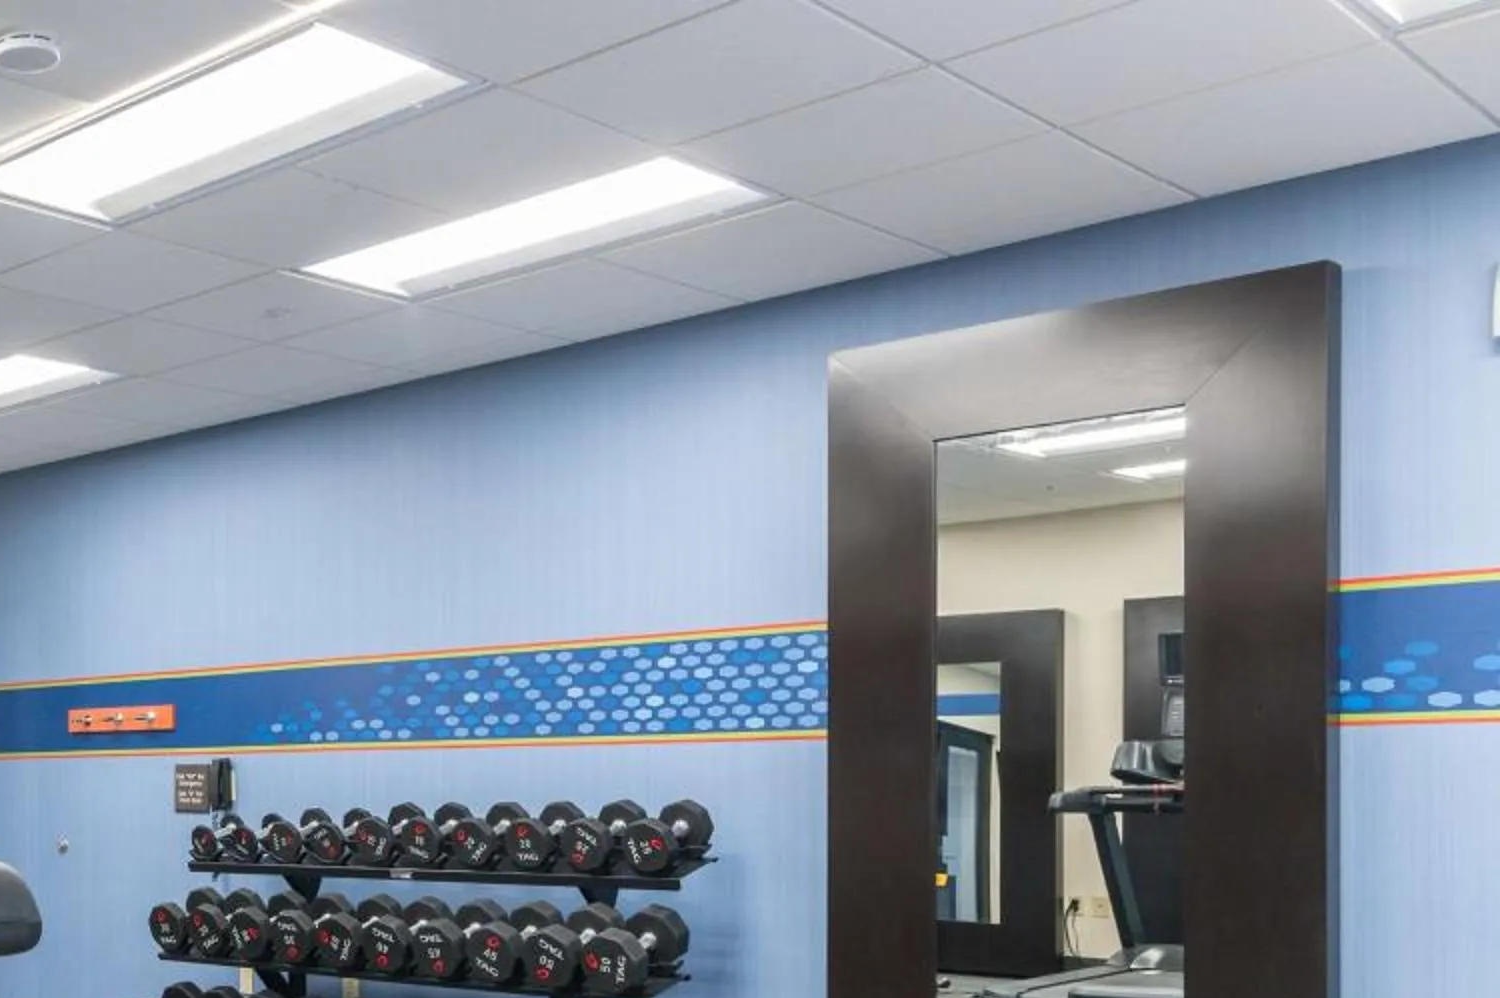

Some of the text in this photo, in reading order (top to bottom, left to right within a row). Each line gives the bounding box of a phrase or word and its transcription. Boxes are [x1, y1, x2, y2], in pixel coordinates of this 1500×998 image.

[627, 837, 642, 864] TAG
[372, 927, 395, 943] TAG
[419, 933, 444, 944] TAG
[538, 939, 565, 962] TAG
[475, 957, 500, 978] TAG
[601, 956, 612, 974] 50
[614, 954, 627, 985] TAG
